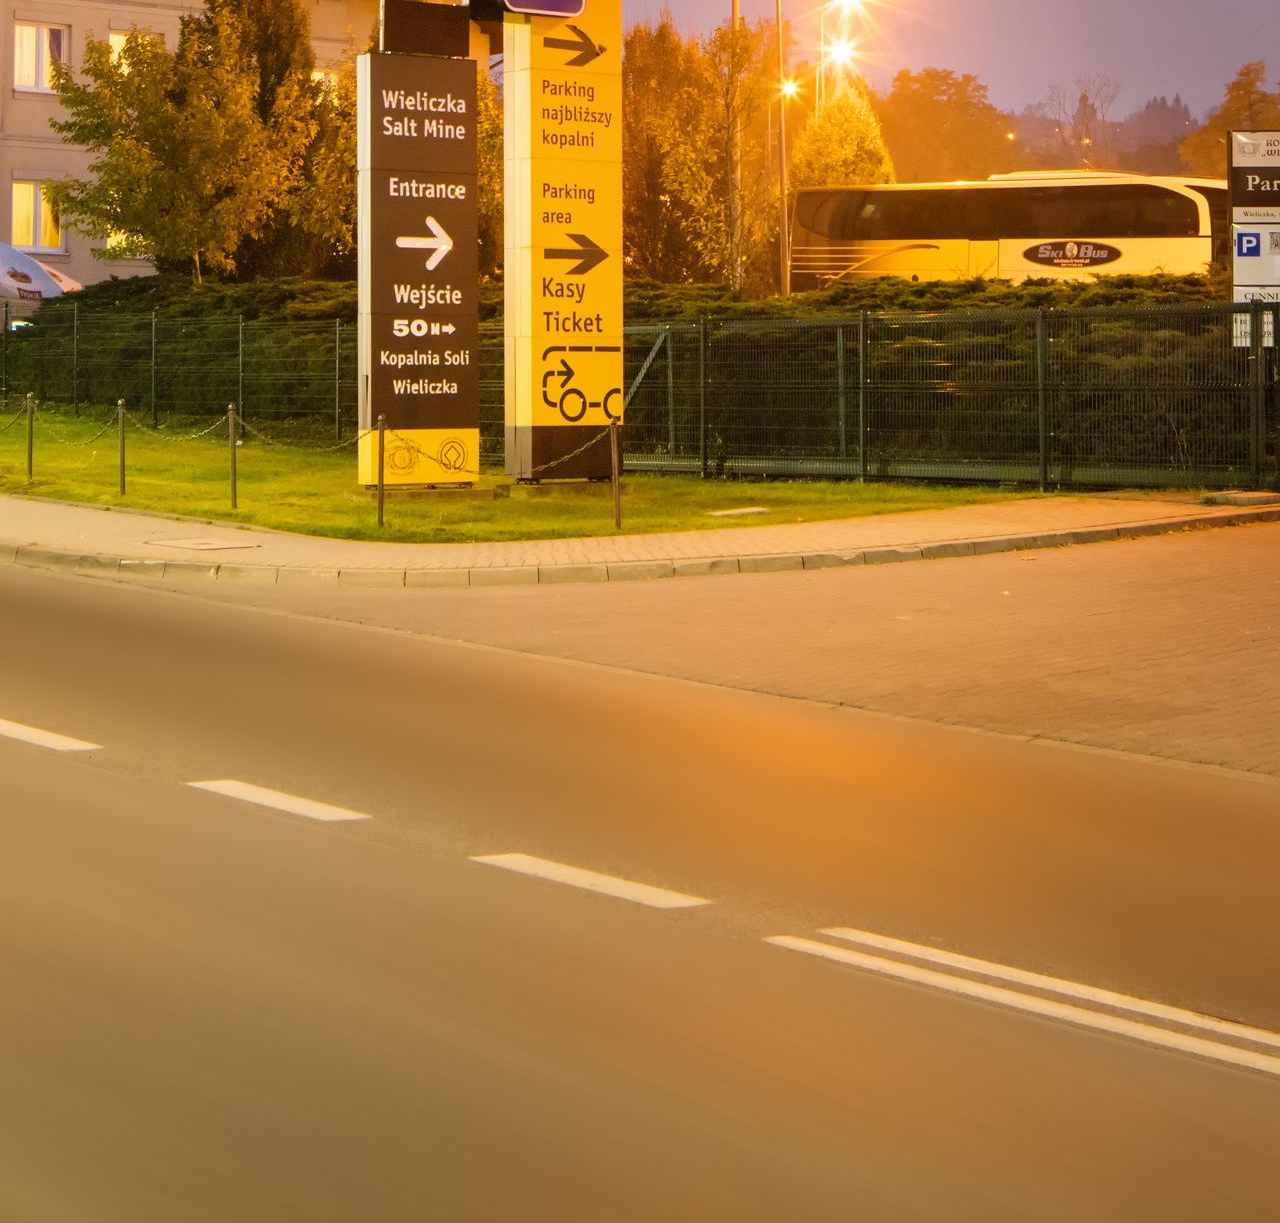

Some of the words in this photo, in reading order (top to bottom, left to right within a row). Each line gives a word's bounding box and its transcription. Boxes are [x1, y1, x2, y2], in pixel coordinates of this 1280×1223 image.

[542, 79, 595, 102] Parking
[382, 90, 467, 114] Wieliczka
[542, 105, 612, 128] najbliższy
[382, 116, 418, 137] Salt
[424, 119, 466, 140] Mine
[542, 129, 595, 149] kopalni
[389, 177, 466, 200] Entrance
[542, 183, 595, 204] Parking
[542, 209, 572, 224] area
[1242, 236, 1257, 253] P
[394, 284, 462, 309] Wejście
[542, 277, 586, 304] Kasy
[543, 312, 603, 333] Ticket
[380, 350, 440, 369] Kopalnia
[444, 350, 470, 366] Soli
[393, 379, 458, 395] Wieliczka
